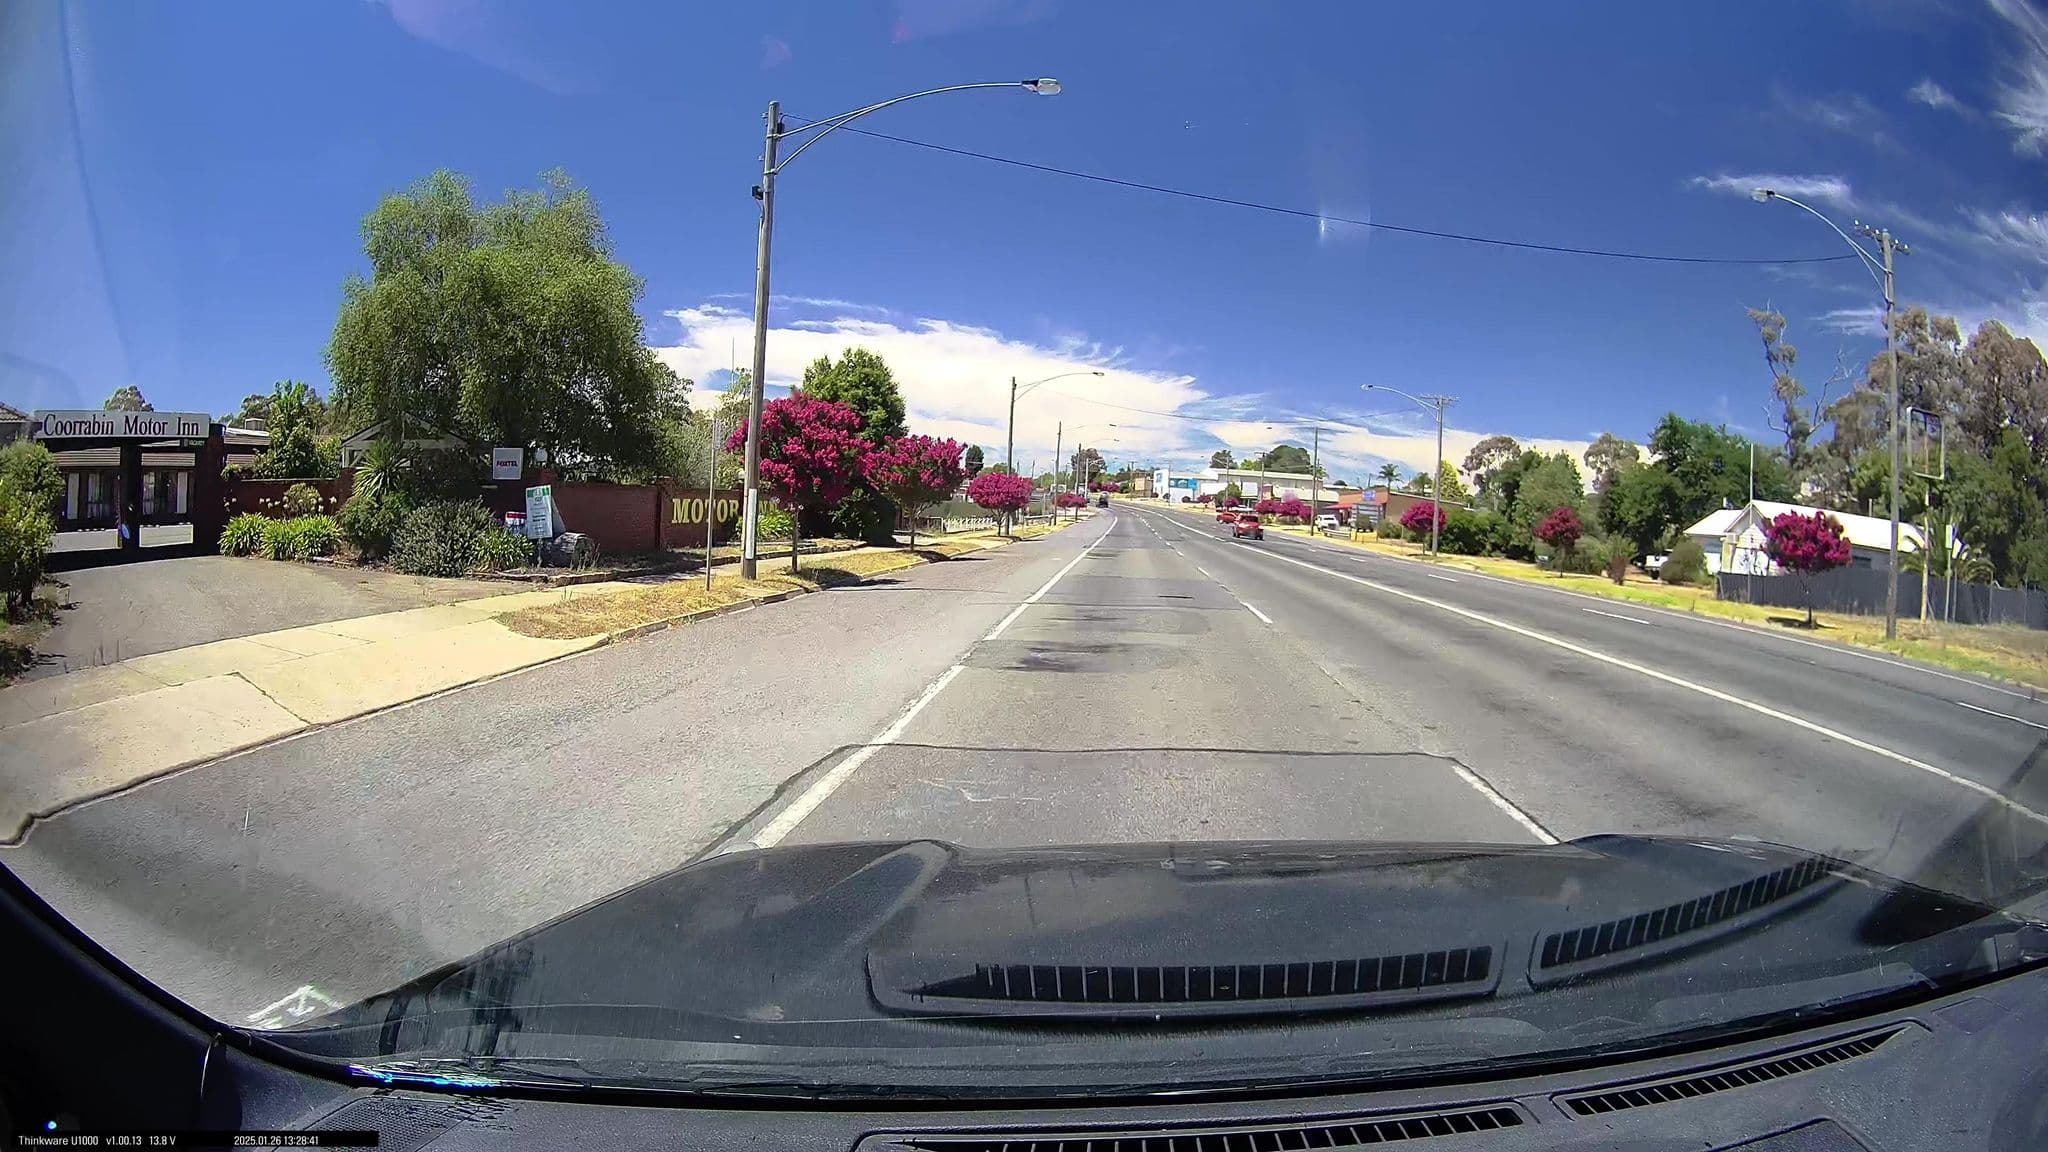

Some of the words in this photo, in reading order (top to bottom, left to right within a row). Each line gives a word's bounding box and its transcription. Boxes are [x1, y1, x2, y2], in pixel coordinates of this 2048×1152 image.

[44, 414, 113, 436] Coorrabin
[124, 415, 168, 436] Motor
[177, 416, 199, 436] Inn
